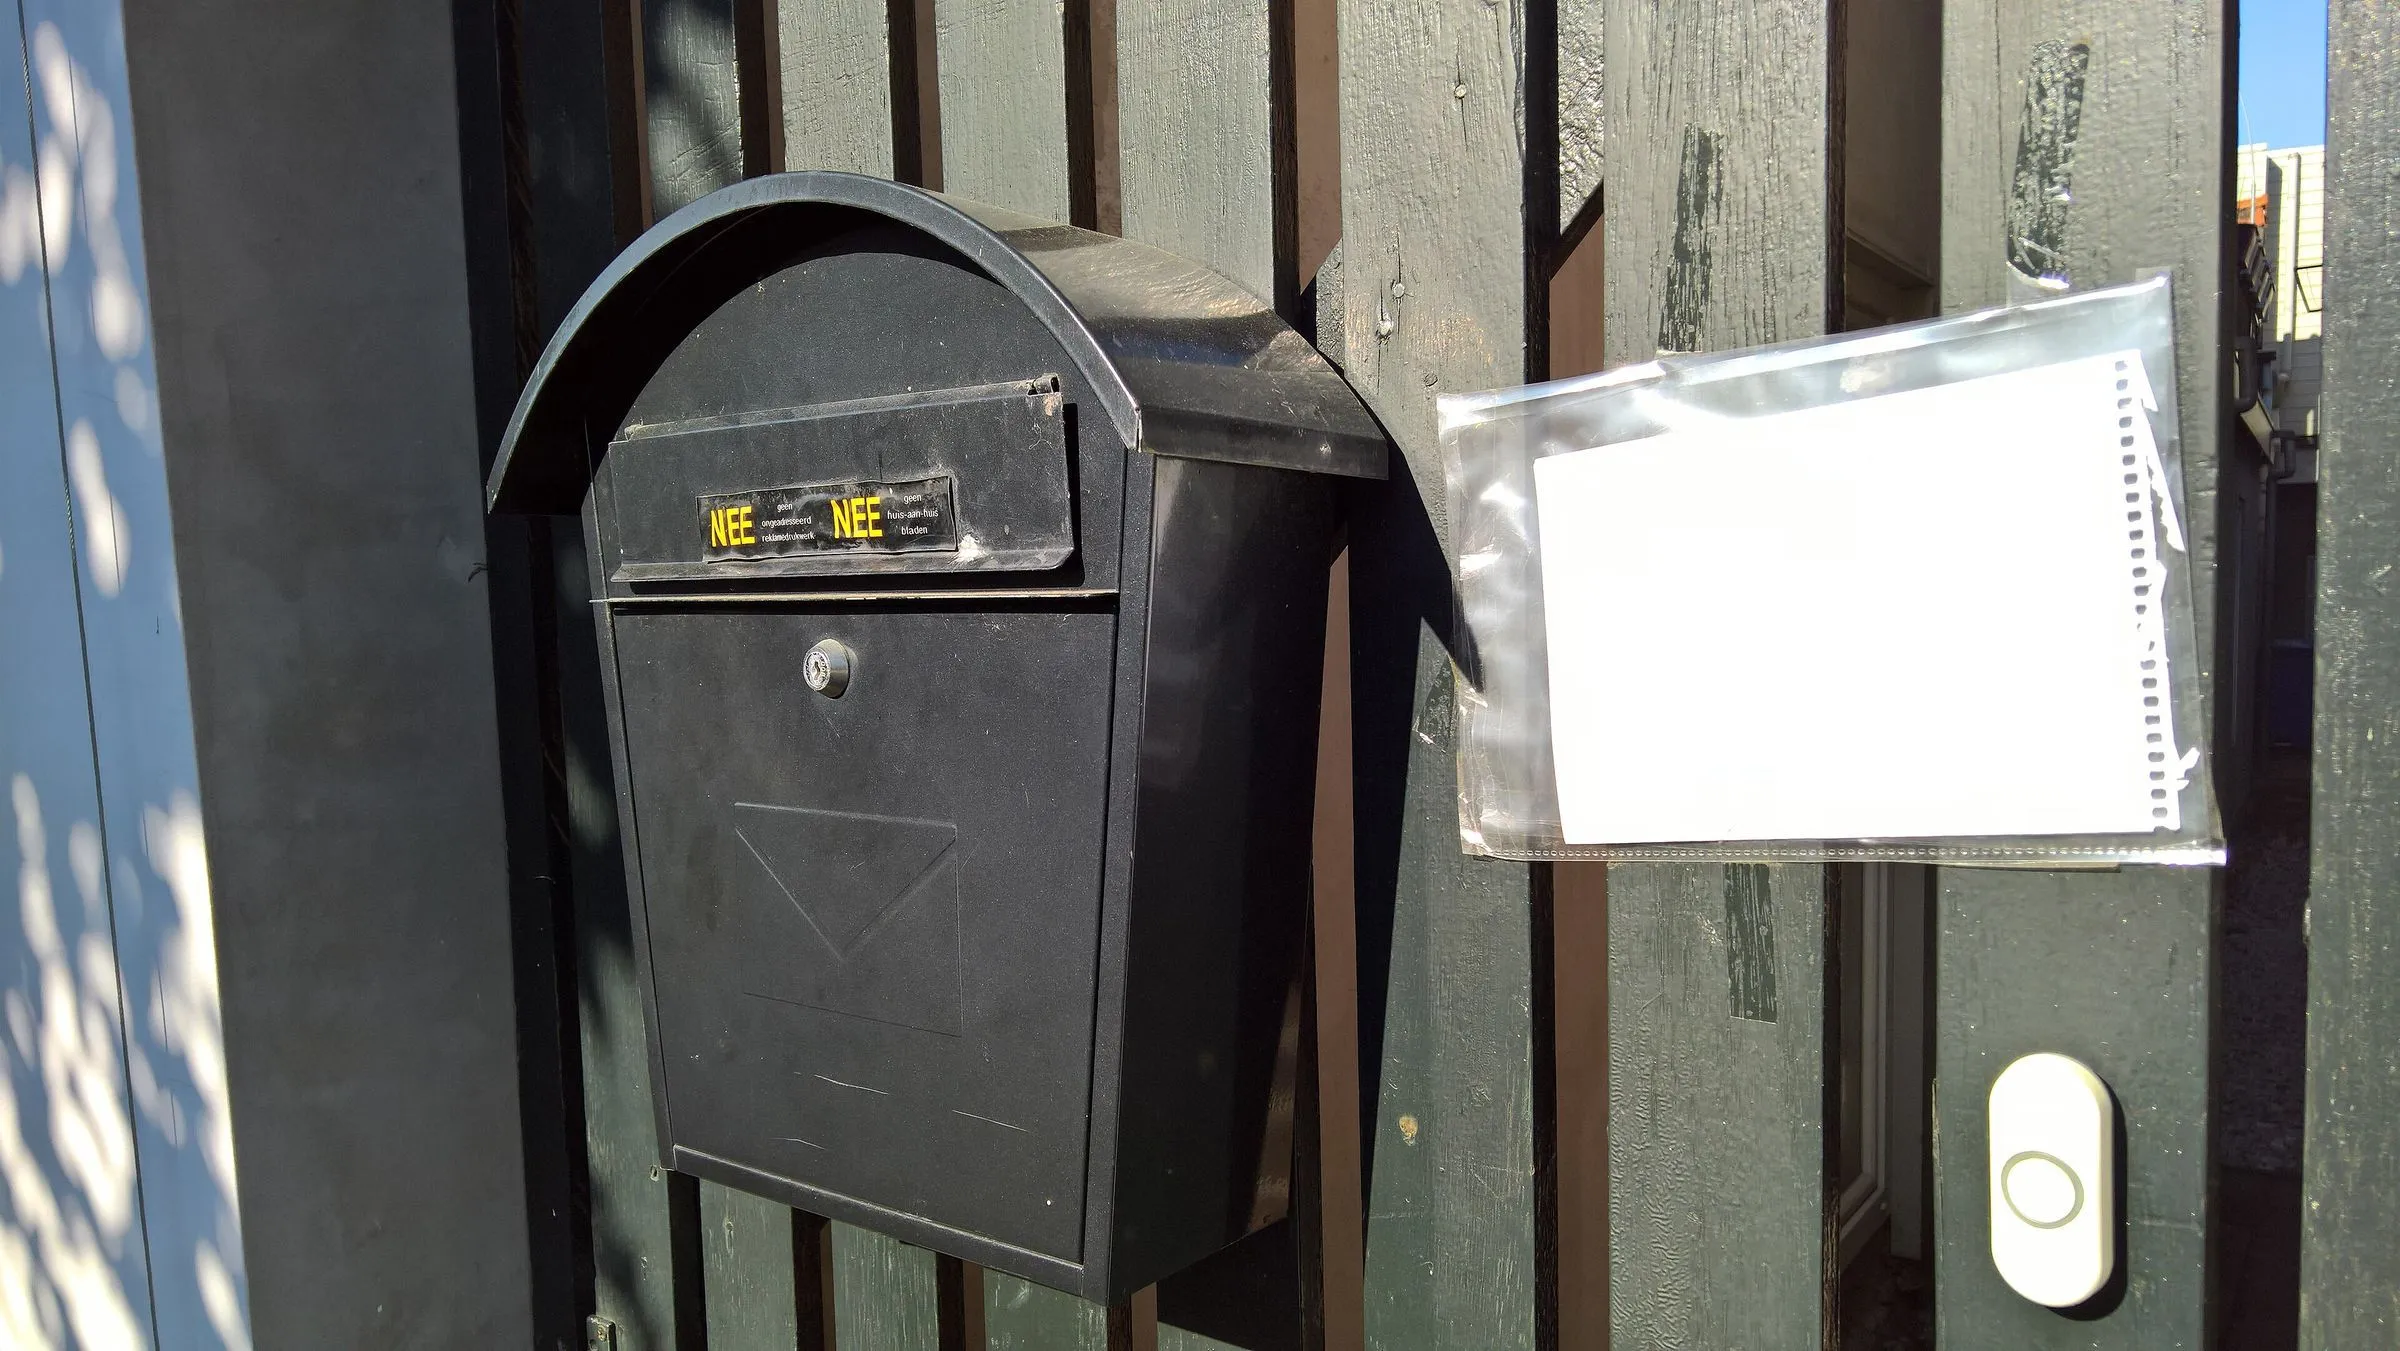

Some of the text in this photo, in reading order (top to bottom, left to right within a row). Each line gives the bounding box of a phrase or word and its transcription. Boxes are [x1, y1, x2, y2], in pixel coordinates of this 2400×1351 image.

[903, 493, 922, 504] geen
[777, 502, 793, 513] geen
[830, 497, 883, 539] NEE
[887, 508, 938, 519] huis-aan-huis
[711, 505, 756, 547] NEE
[761, 516, 812, 528] ongeadresseerd
[901, 526, 928, 535] bladen
